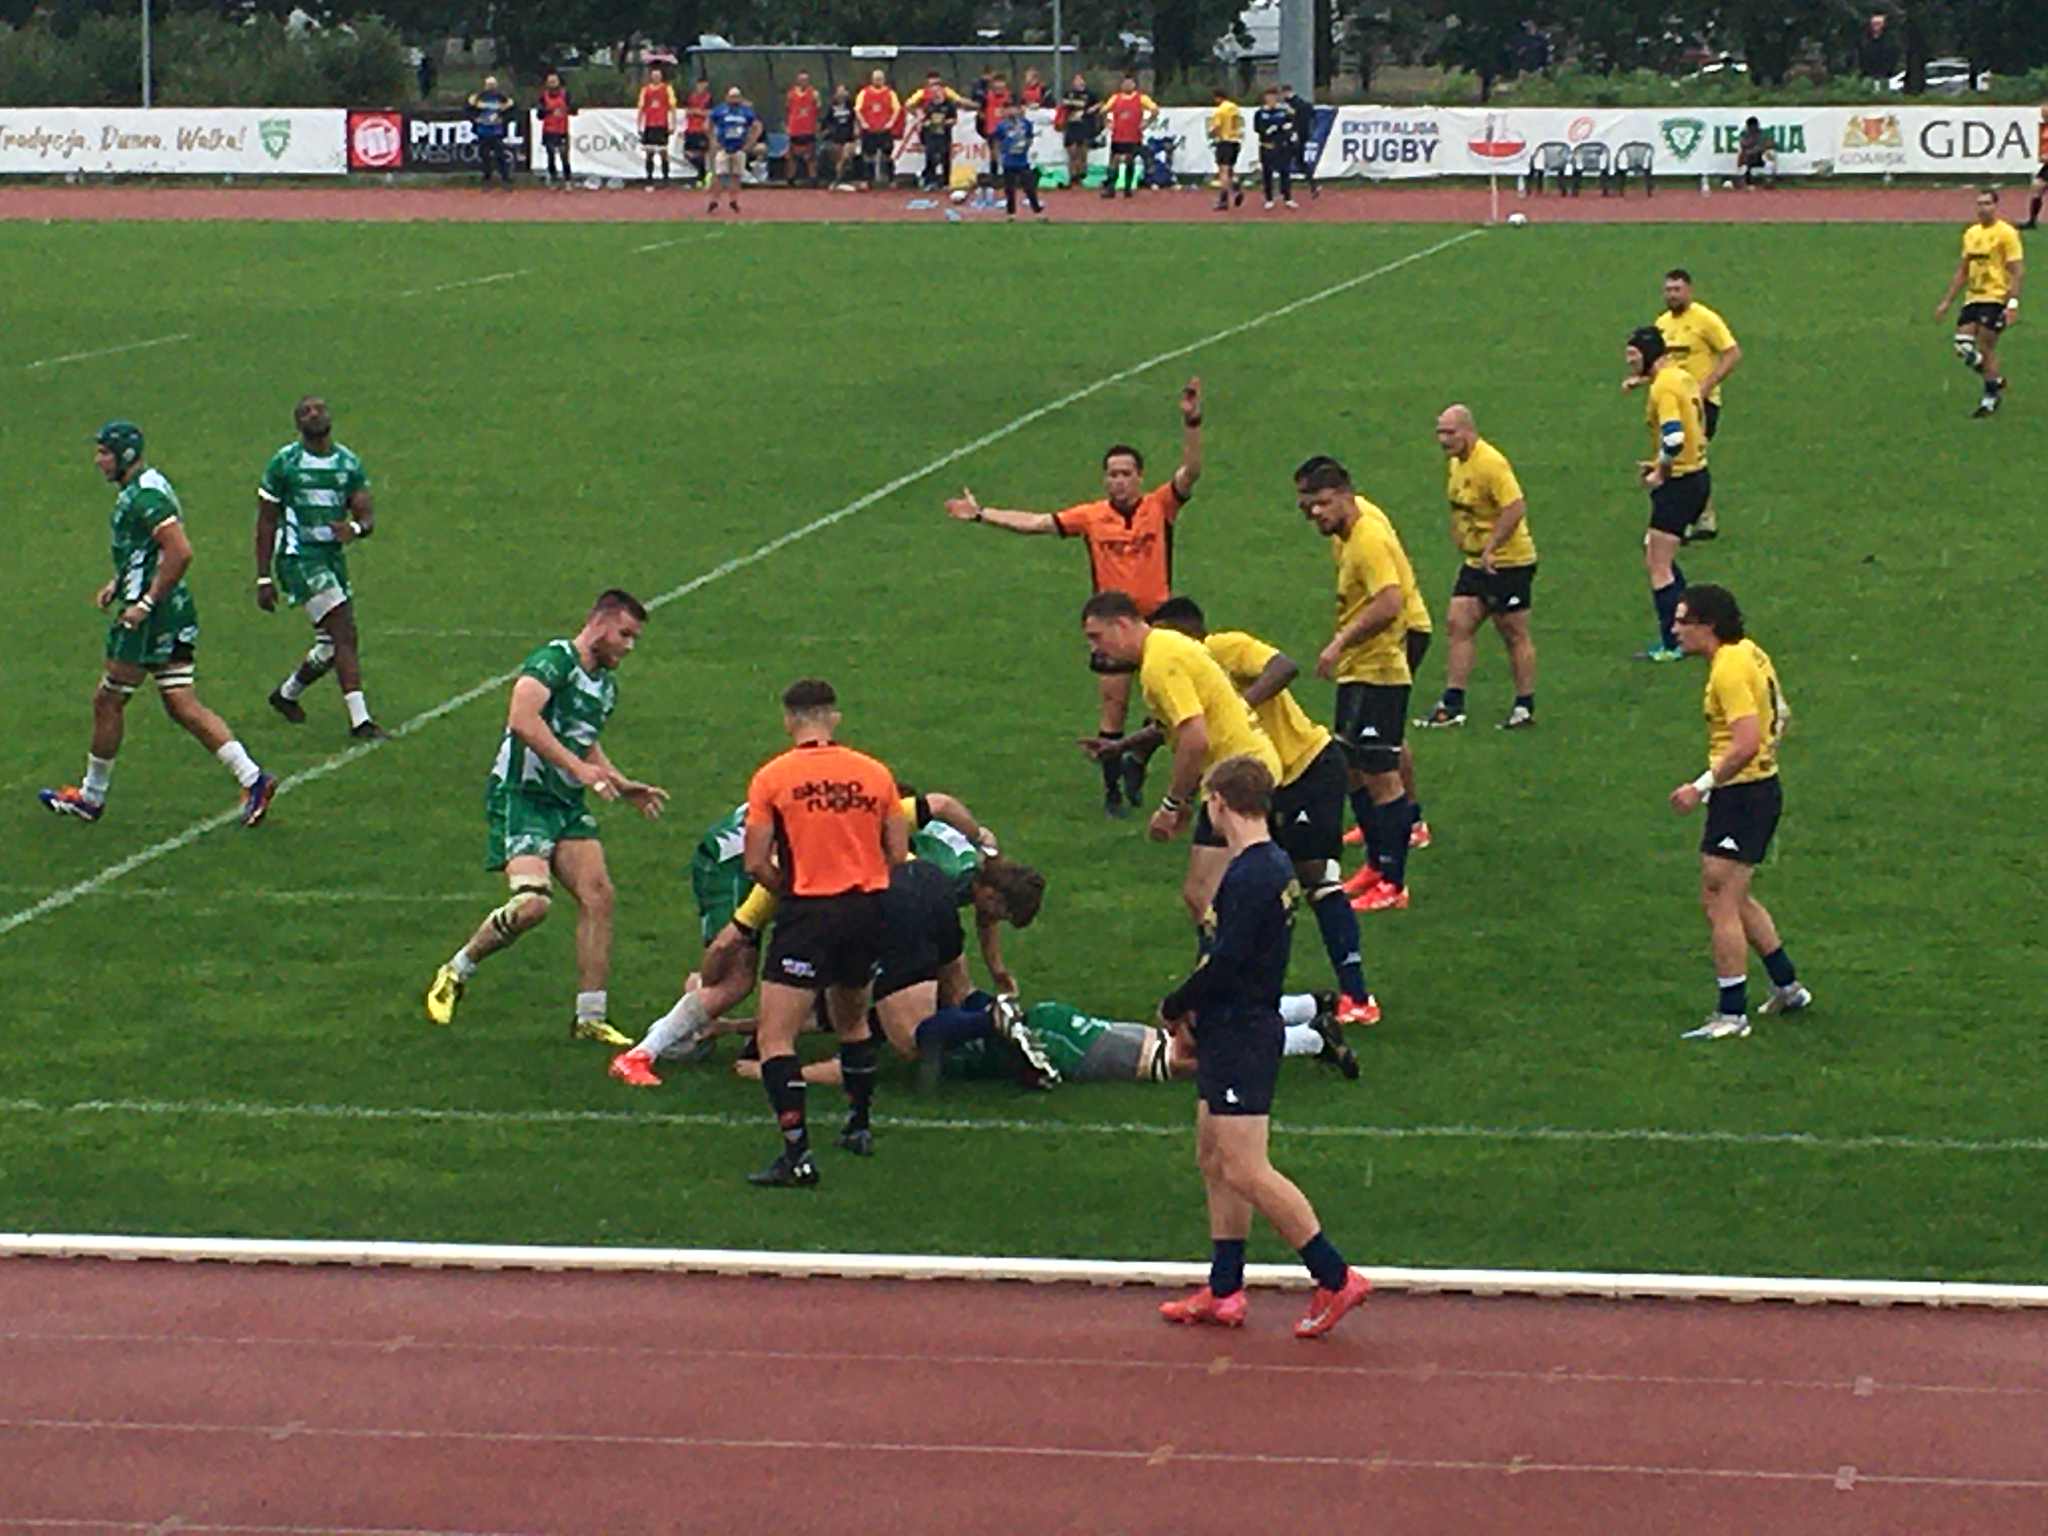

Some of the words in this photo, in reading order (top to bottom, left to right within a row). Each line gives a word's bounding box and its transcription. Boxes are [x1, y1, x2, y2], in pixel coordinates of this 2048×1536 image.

[410, 120, 524, 145] PITBL
[1341, 120, 1440, 136] EKSTRALIGA
[1713, 125, 1807, 153] LEIA
[1342, 138, 1440, 163] RUGBY
